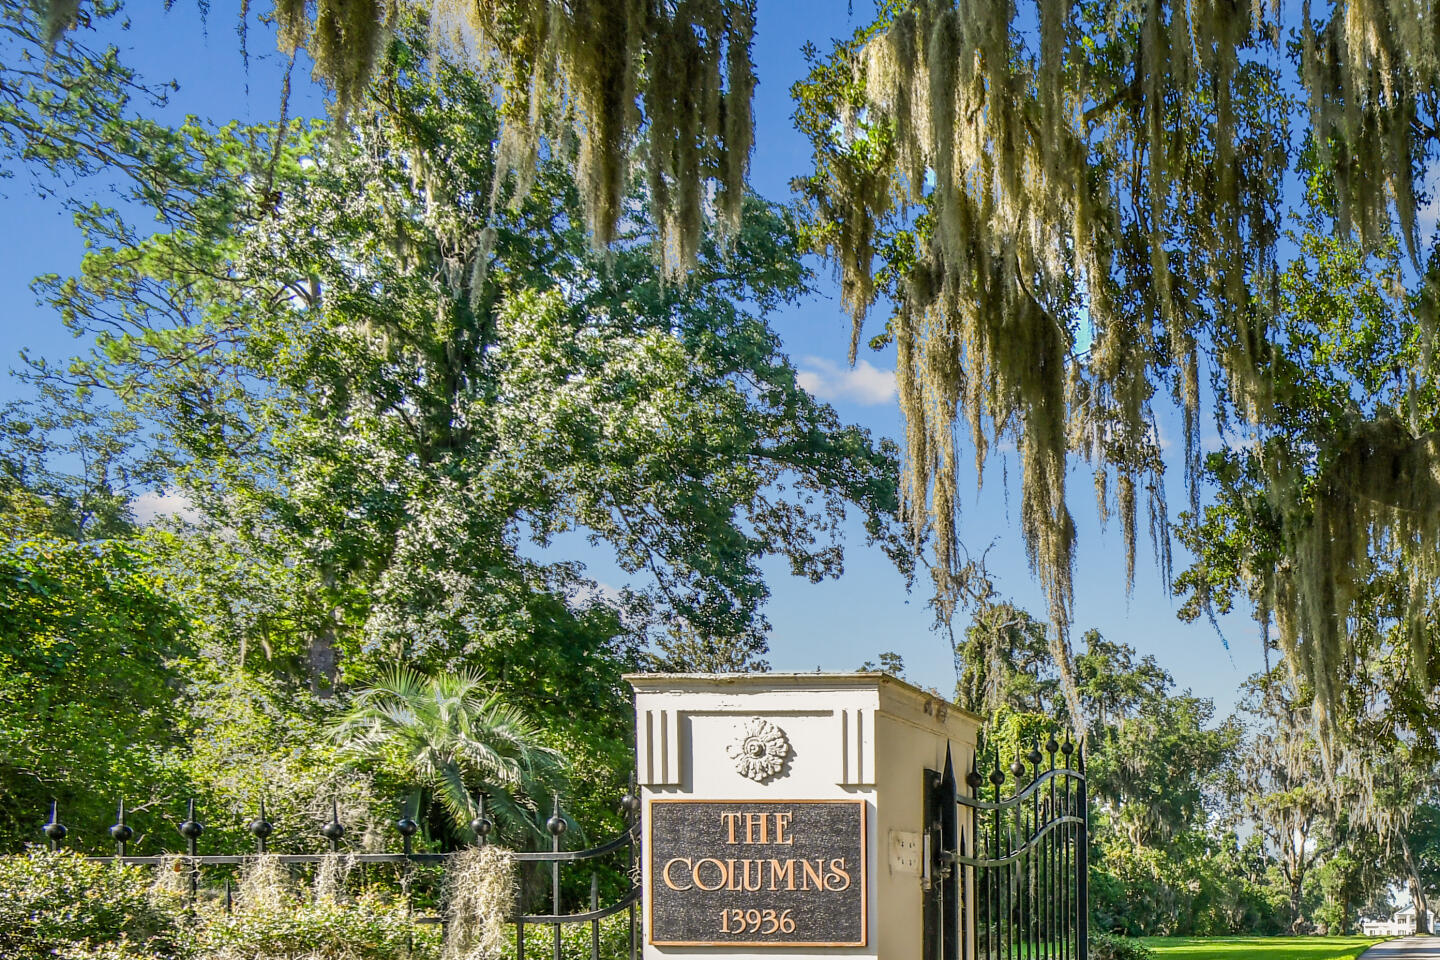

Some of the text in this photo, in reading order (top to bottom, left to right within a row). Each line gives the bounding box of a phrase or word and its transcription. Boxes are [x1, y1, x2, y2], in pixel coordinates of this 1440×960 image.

[721, 810, 794, 846] THE
[662, 857, 851, 892] COLUMNS
[719, 908, 796, 935] 13936
